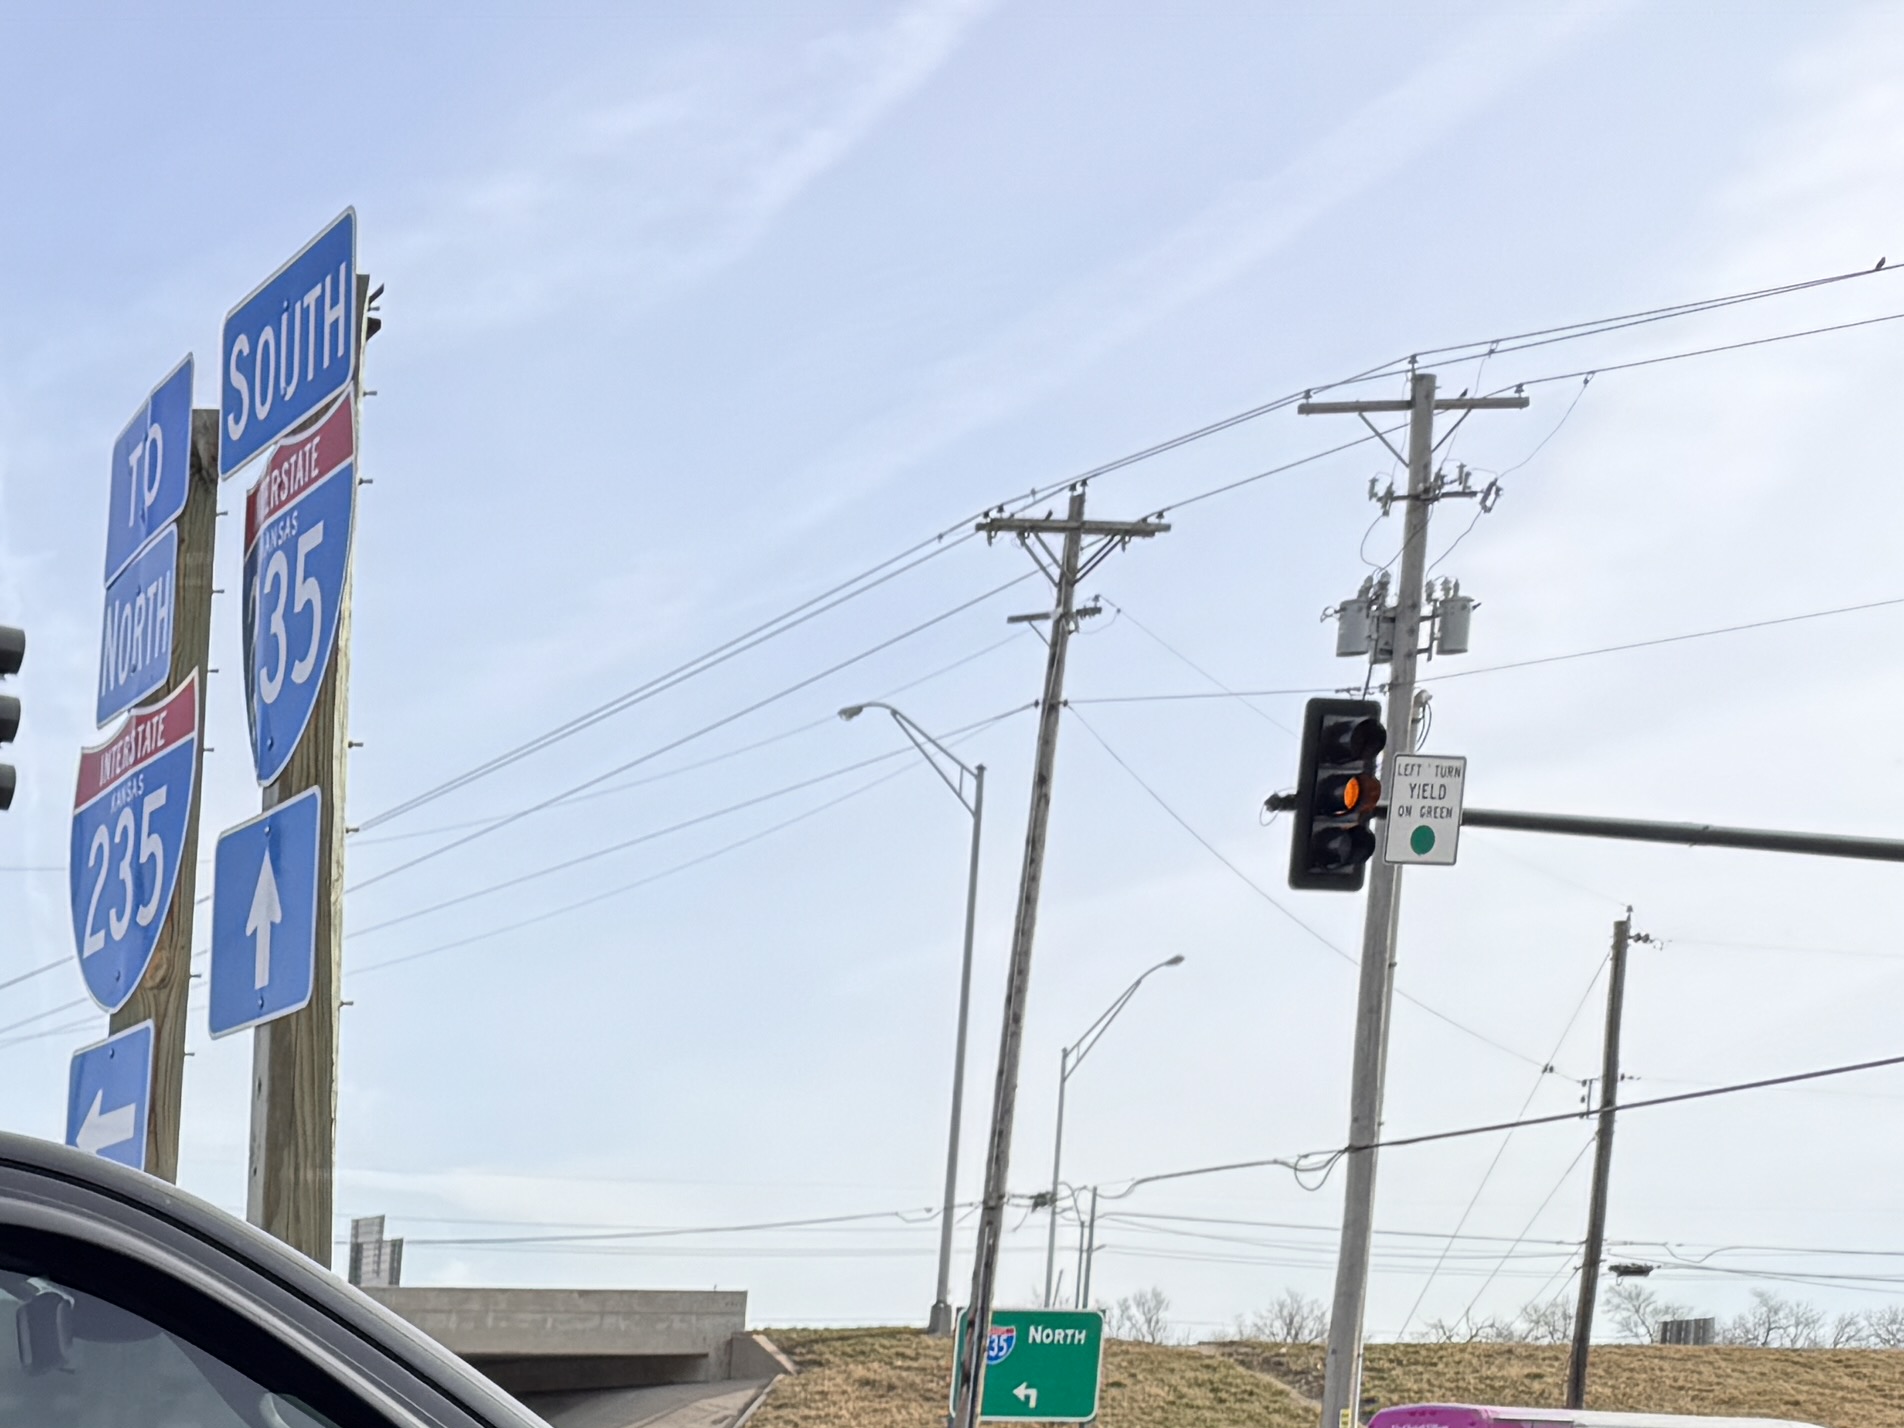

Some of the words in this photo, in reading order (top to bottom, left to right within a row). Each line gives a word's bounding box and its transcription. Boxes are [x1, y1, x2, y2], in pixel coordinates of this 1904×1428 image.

[225, 262, 347, 442] SOUTH
[127, 423, 164, 528] TO
[258, 509, 299, 552] ANSAS
[101, 569, 171, 697] NORTH
[99, 709, 168, 788] INTERSTATE
[1397, 763, 1422, 777] LEFT
[1434, 764, 1462, 779] TURN
[1409, 782, 1447, 801] YIELD
[110, 773, 145, 813] KANSAS
[1397, 805, 1413, 818] ON
[1419, 805, 1454, 819] GREEN
[82, 784, 169, 961] 235
[986, 1334, 1008, 1357] 35
[1028, 1325, 1087, 1346] NORTH
